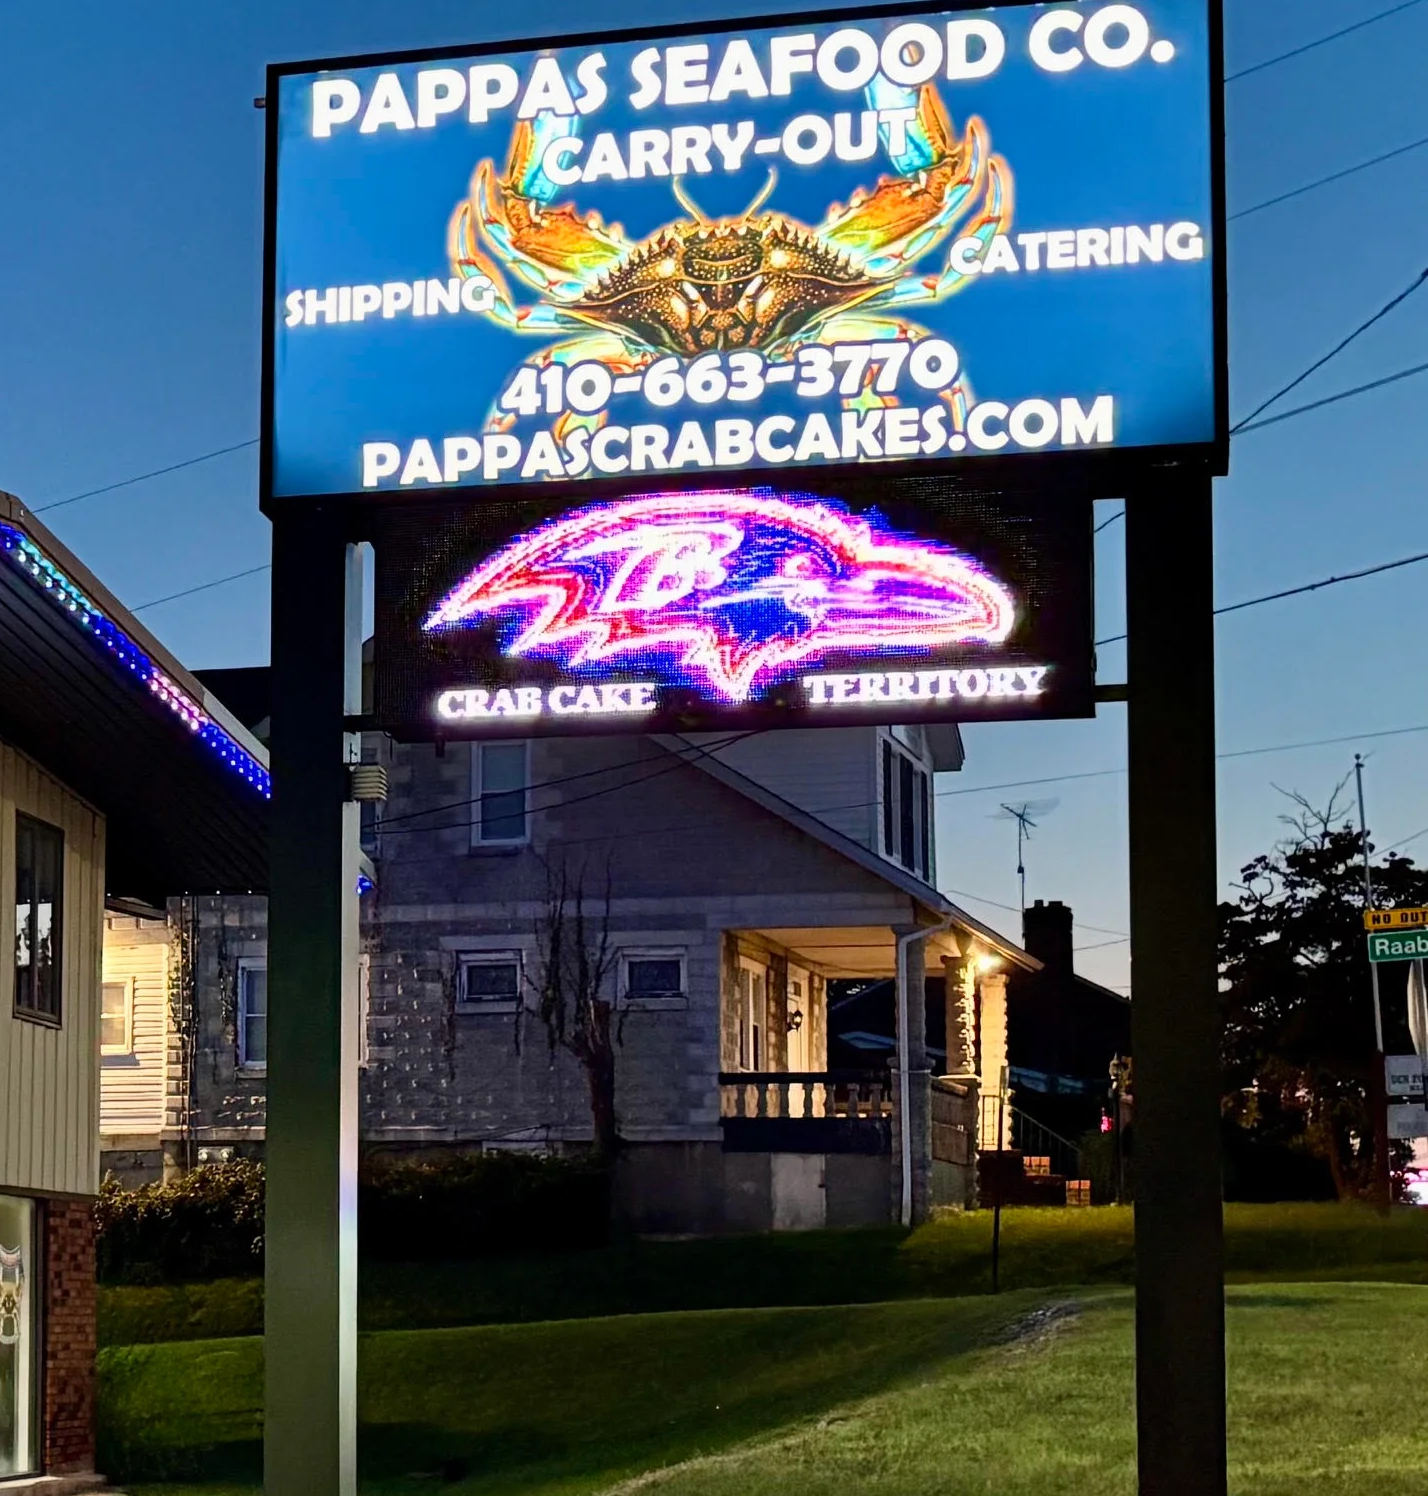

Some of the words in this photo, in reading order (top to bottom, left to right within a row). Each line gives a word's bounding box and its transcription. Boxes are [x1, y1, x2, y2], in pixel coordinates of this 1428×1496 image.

[310, 52, 609, 138] PAPPAS
[630, 19, 1005, 109] SEAFOOD
[1027, 4, 1176, 73] CO.
[541, 107, 918, 187] CARRY-OUT
[948, 221, 1205, 276] CATERING
[284, 273, 497, 328] SHIPPING
[497, 338, 960, 418] 410-663-3770
[361, 395, 1115, 488] PAPPASCRABCAKES.COM
[437, 686, 543, 719] CRAB
[547, 682, 657, 715] CAKE
[802, 666, 1049, 704] TERRITORY
[1371, 913, 1391, 925] NO
[1374, 935, 1428, 956] Raab
